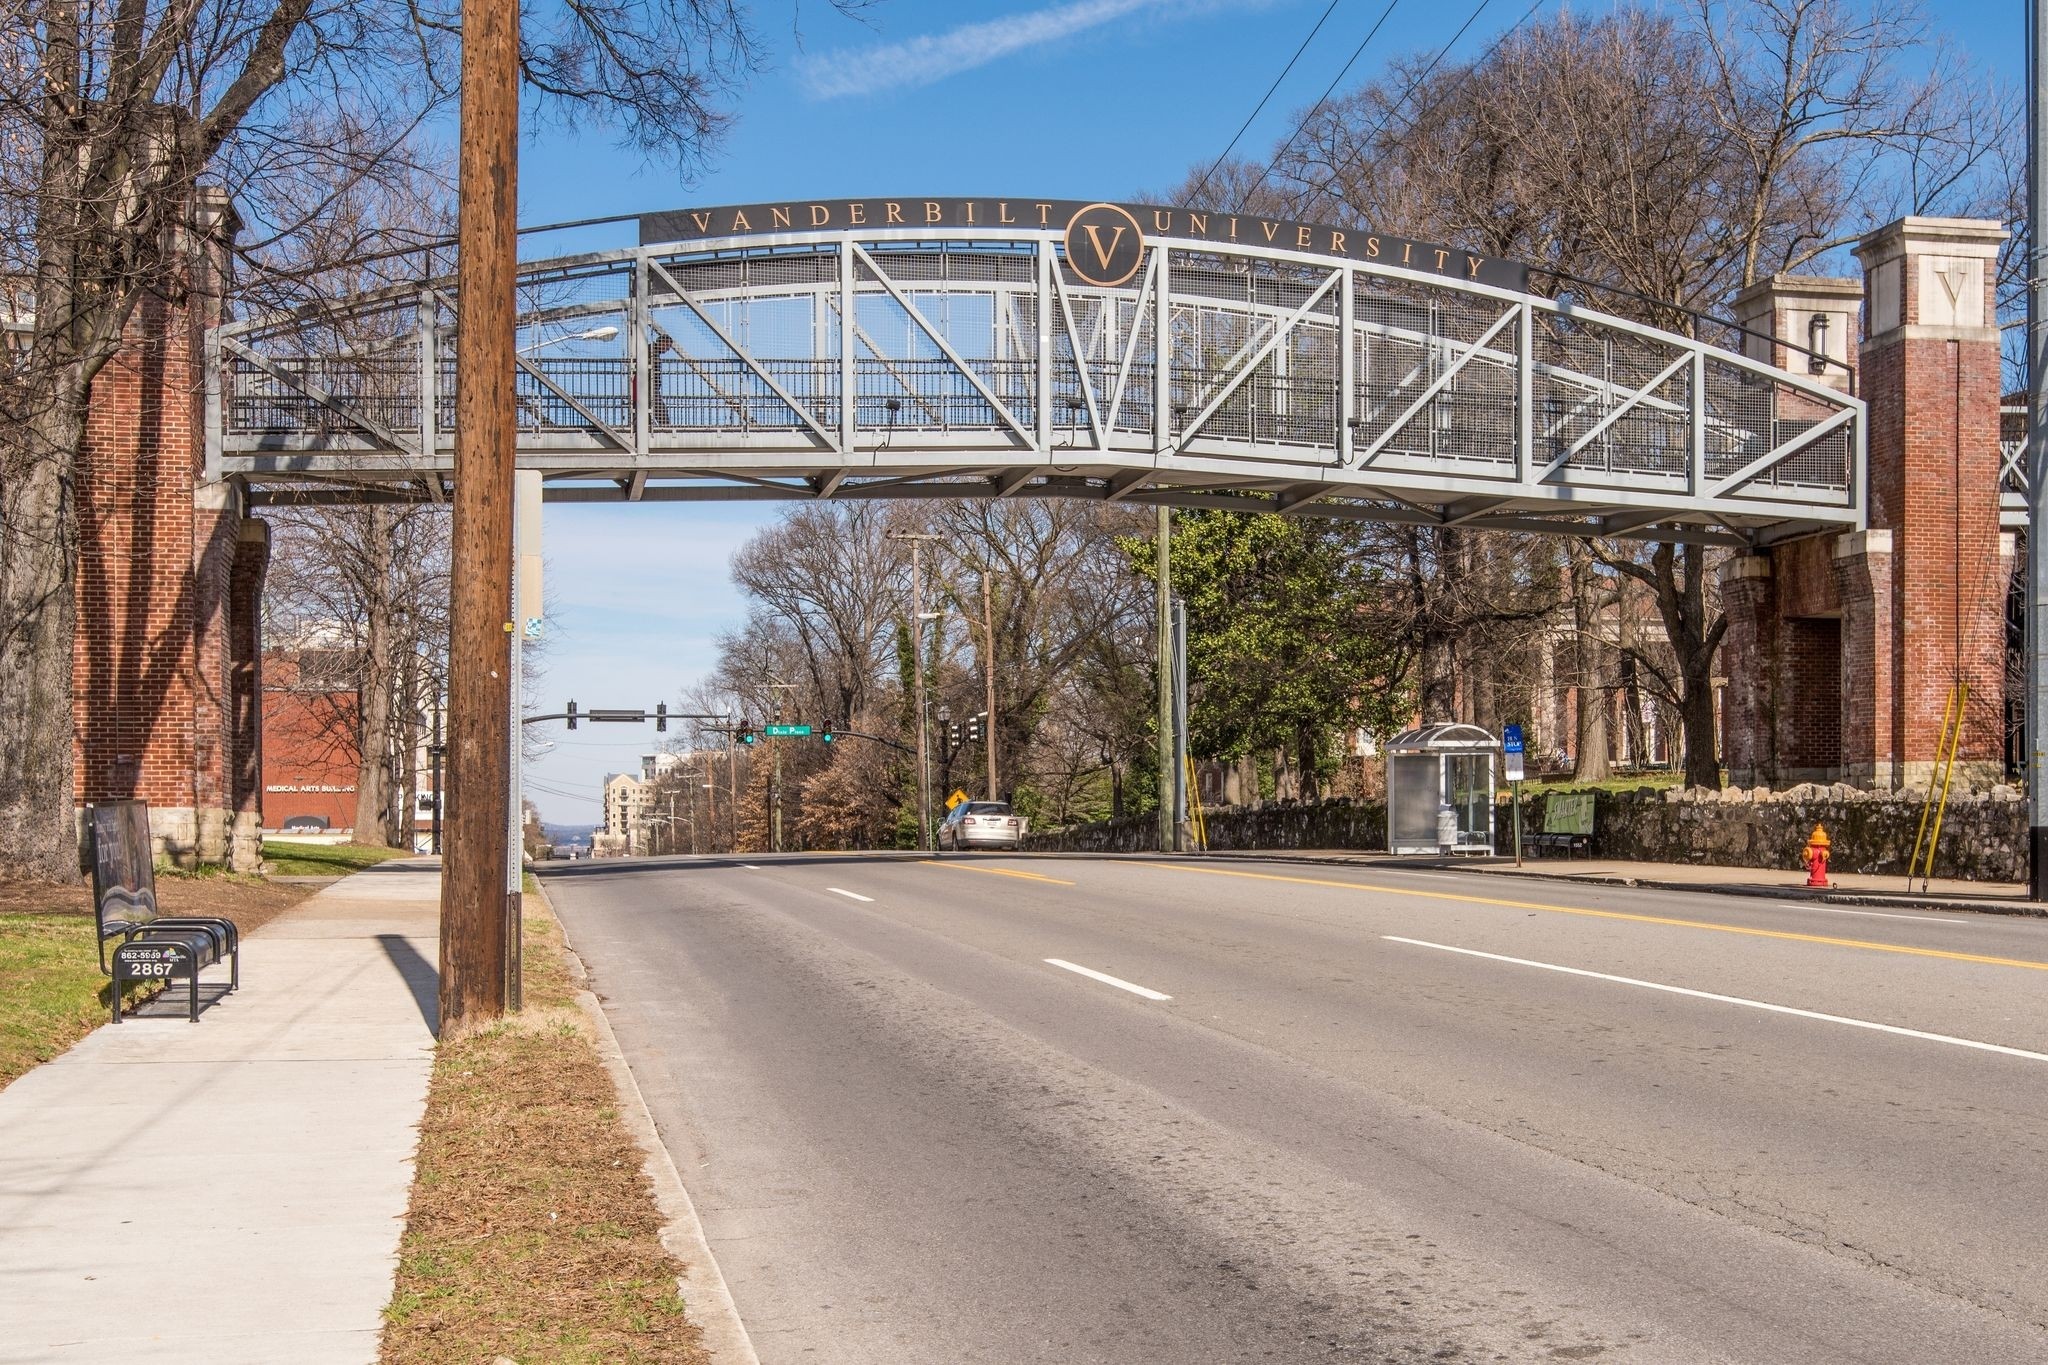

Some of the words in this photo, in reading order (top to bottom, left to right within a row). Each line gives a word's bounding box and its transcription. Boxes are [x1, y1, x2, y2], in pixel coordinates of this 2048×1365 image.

[691, 202, 1052, 233] VANDERBILT
[1082, 225, 1127, 270] V
[1154, 210, 1484, 277] UNIVERSITY
[1934, 271, 1968, 309] V
[131, 963, 173, 976] 2867
